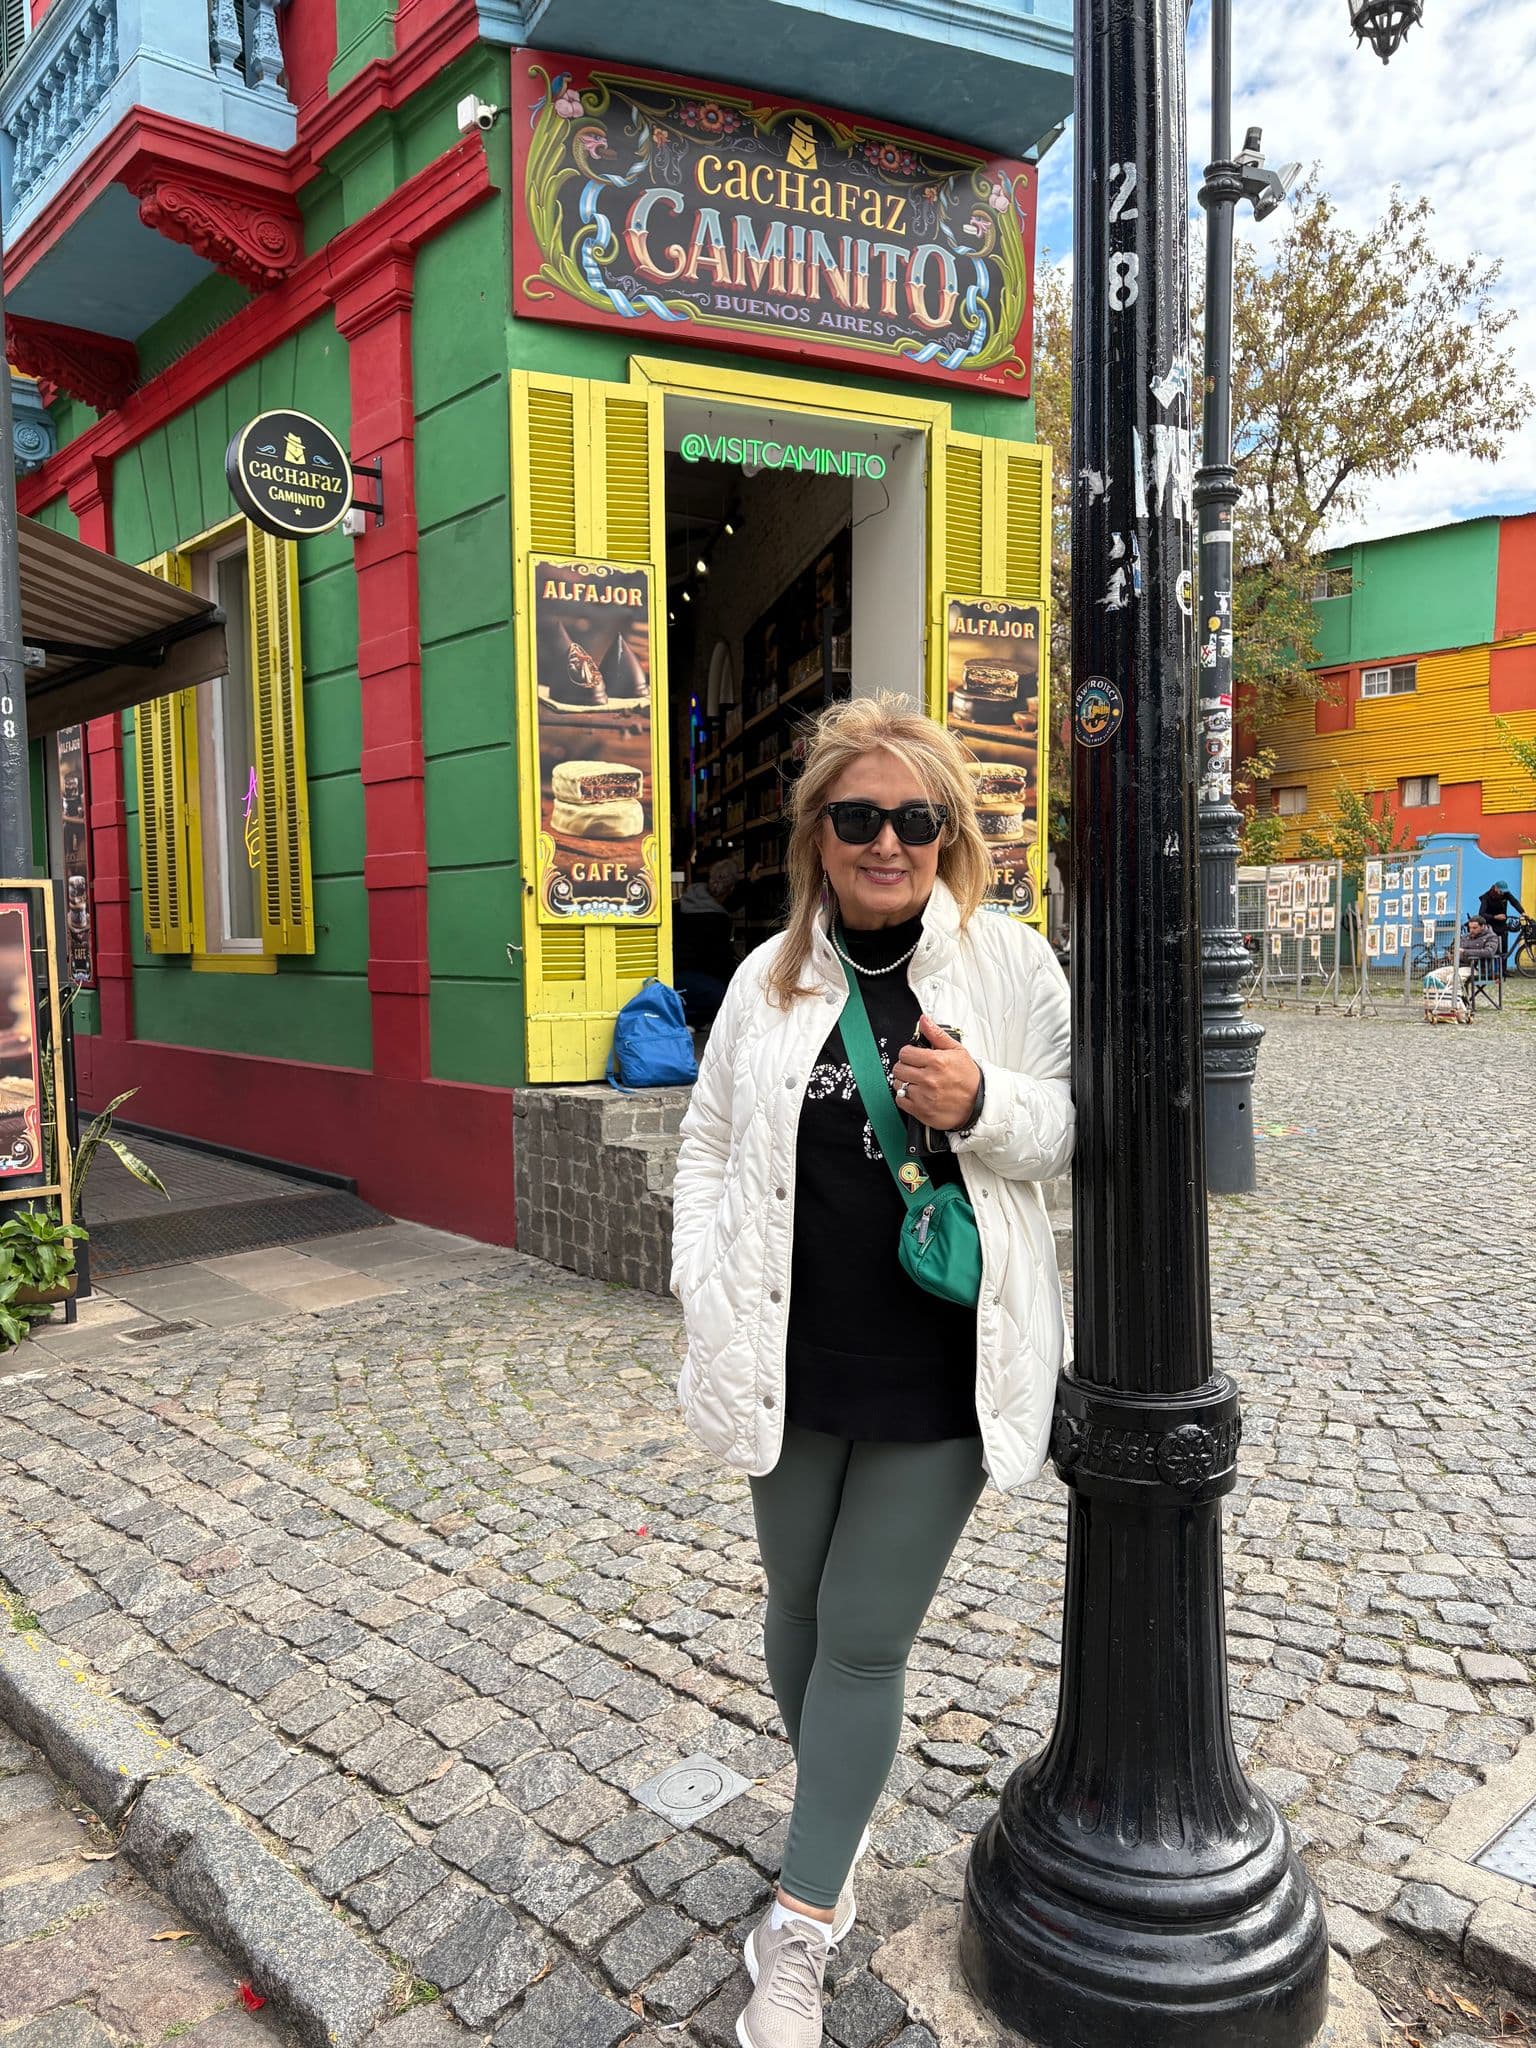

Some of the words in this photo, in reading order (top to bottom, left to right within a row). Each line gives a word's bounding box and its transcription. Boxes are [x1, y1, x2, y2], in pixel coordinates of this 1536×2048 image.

[623, 187, 959, 330] CAMINITO
[714, 294, 811, 322] BUENOS
[818, 312, 884, 336] AIRES
[680, 433, 887, 480] @VISITCAMINITO
[268, 485, 326, 510] CAMINITO
[542, 580, 643, 607] ALFAJOR
[955, 616, 1035, 639] ALFAJOR
[571, 862, 628, 881] CAFE
[994, 868, 1015, 885] FE
